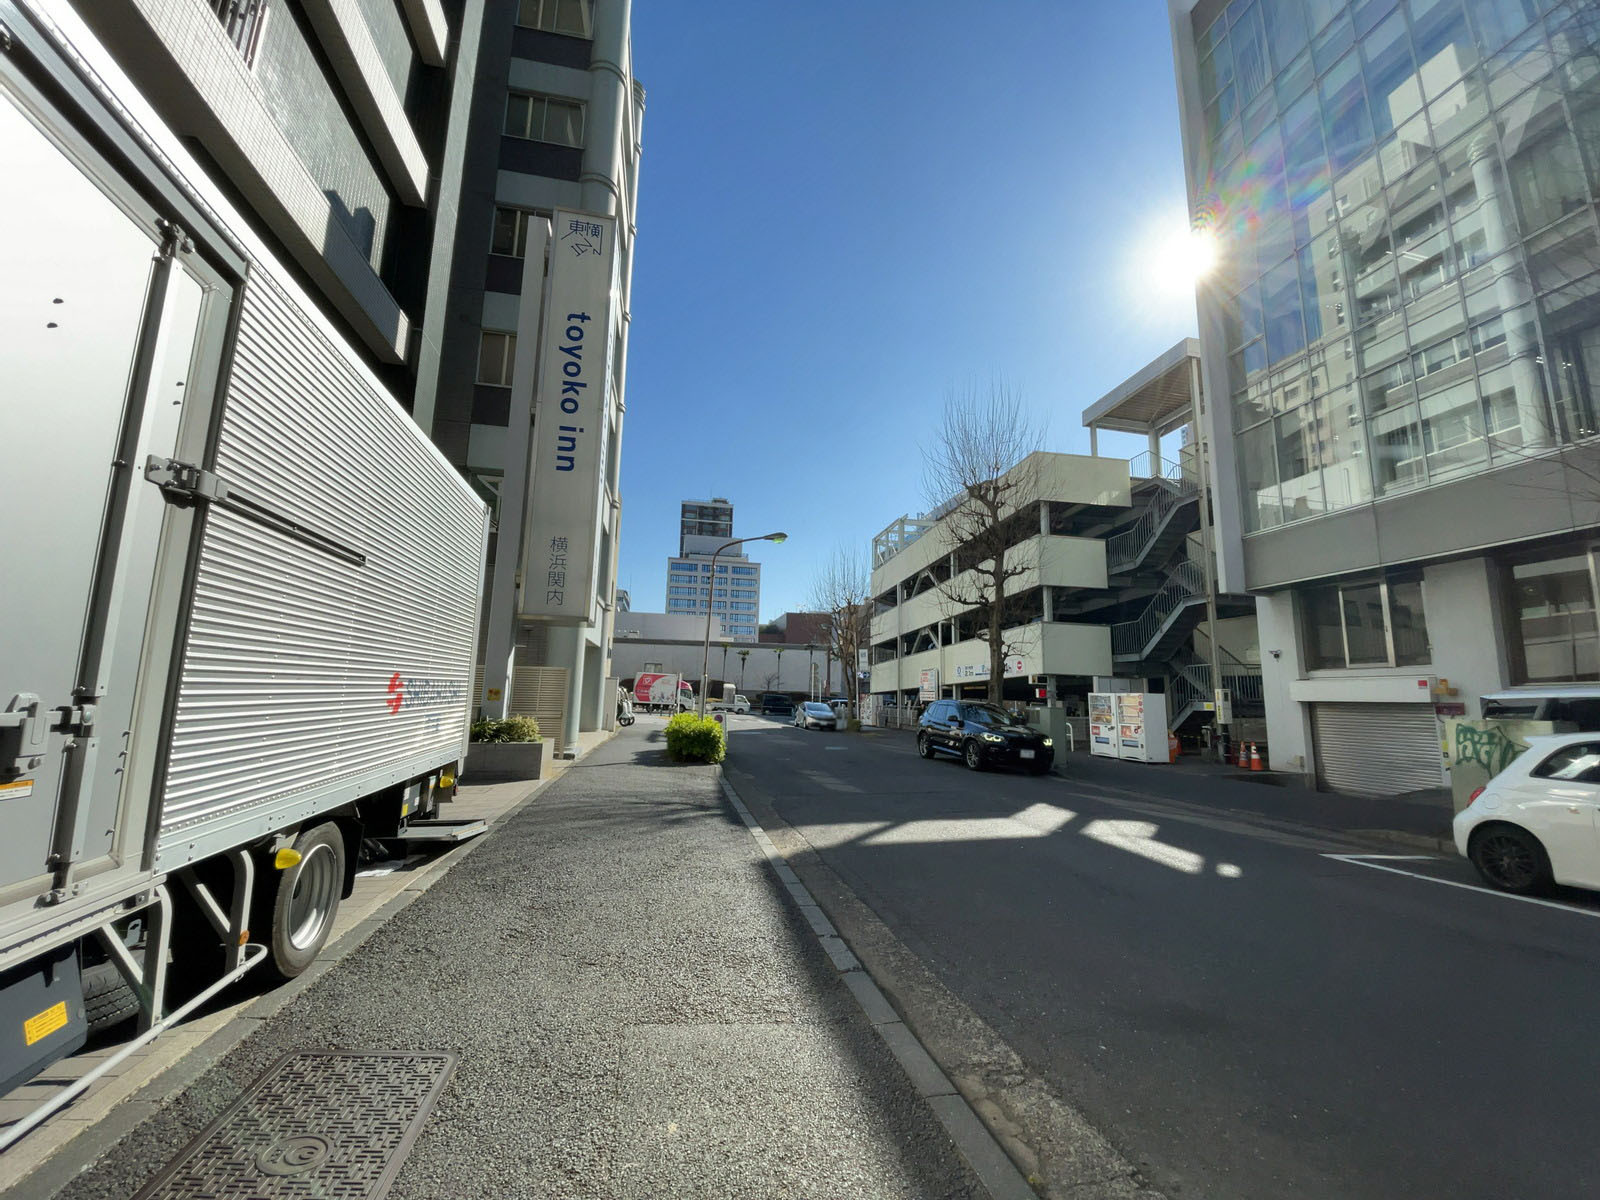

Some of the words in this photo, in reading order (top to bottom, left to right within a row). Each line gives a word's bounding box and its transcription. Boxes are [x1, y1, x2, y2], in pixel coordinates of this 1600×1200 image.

[558, 311, 592, 414] toyoko
[555, 425, 585, 472] inn
[546, 535, 569, 606] 横浜関内
